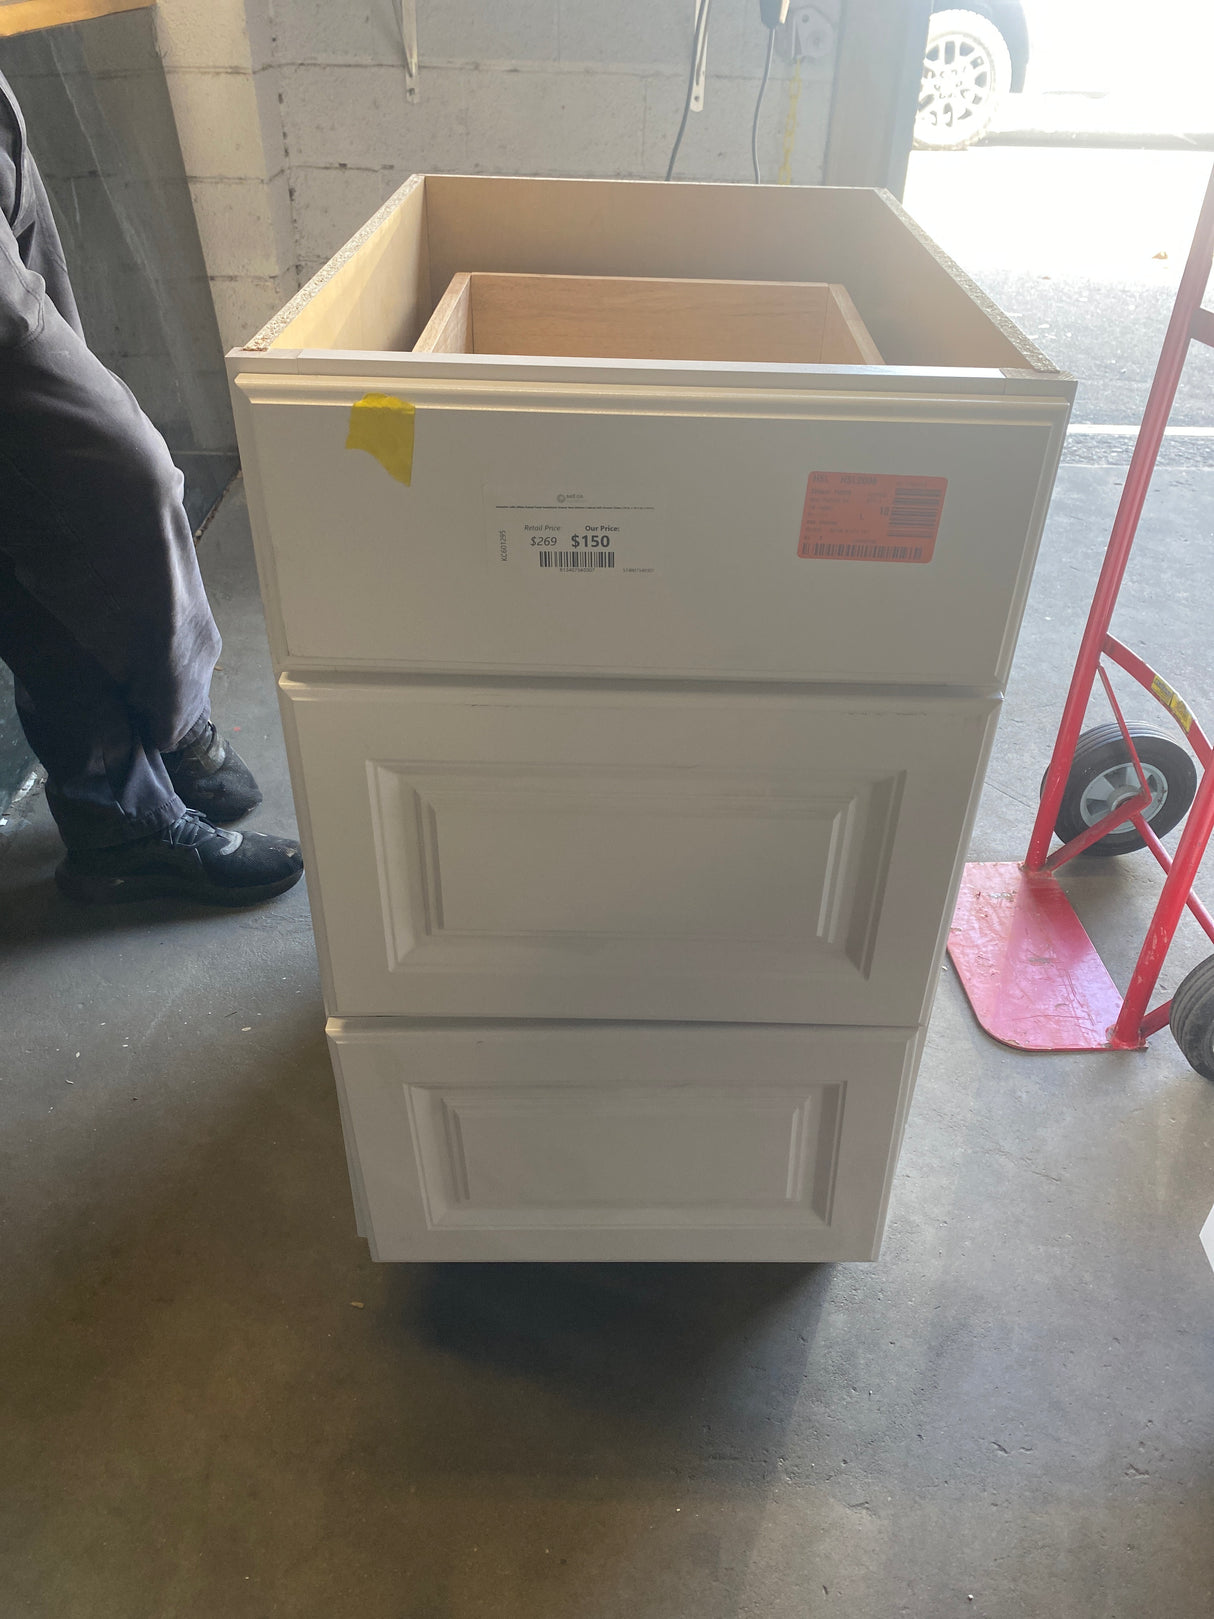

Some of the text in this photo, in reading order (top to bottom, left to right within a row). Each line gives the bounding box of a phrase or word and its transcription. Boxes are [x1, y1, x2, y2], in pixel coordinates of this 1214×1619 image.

[600, 525, 620, 533] Price:
[530, 536, 558, 547] $269
[571, 533, 611, 549] $150
